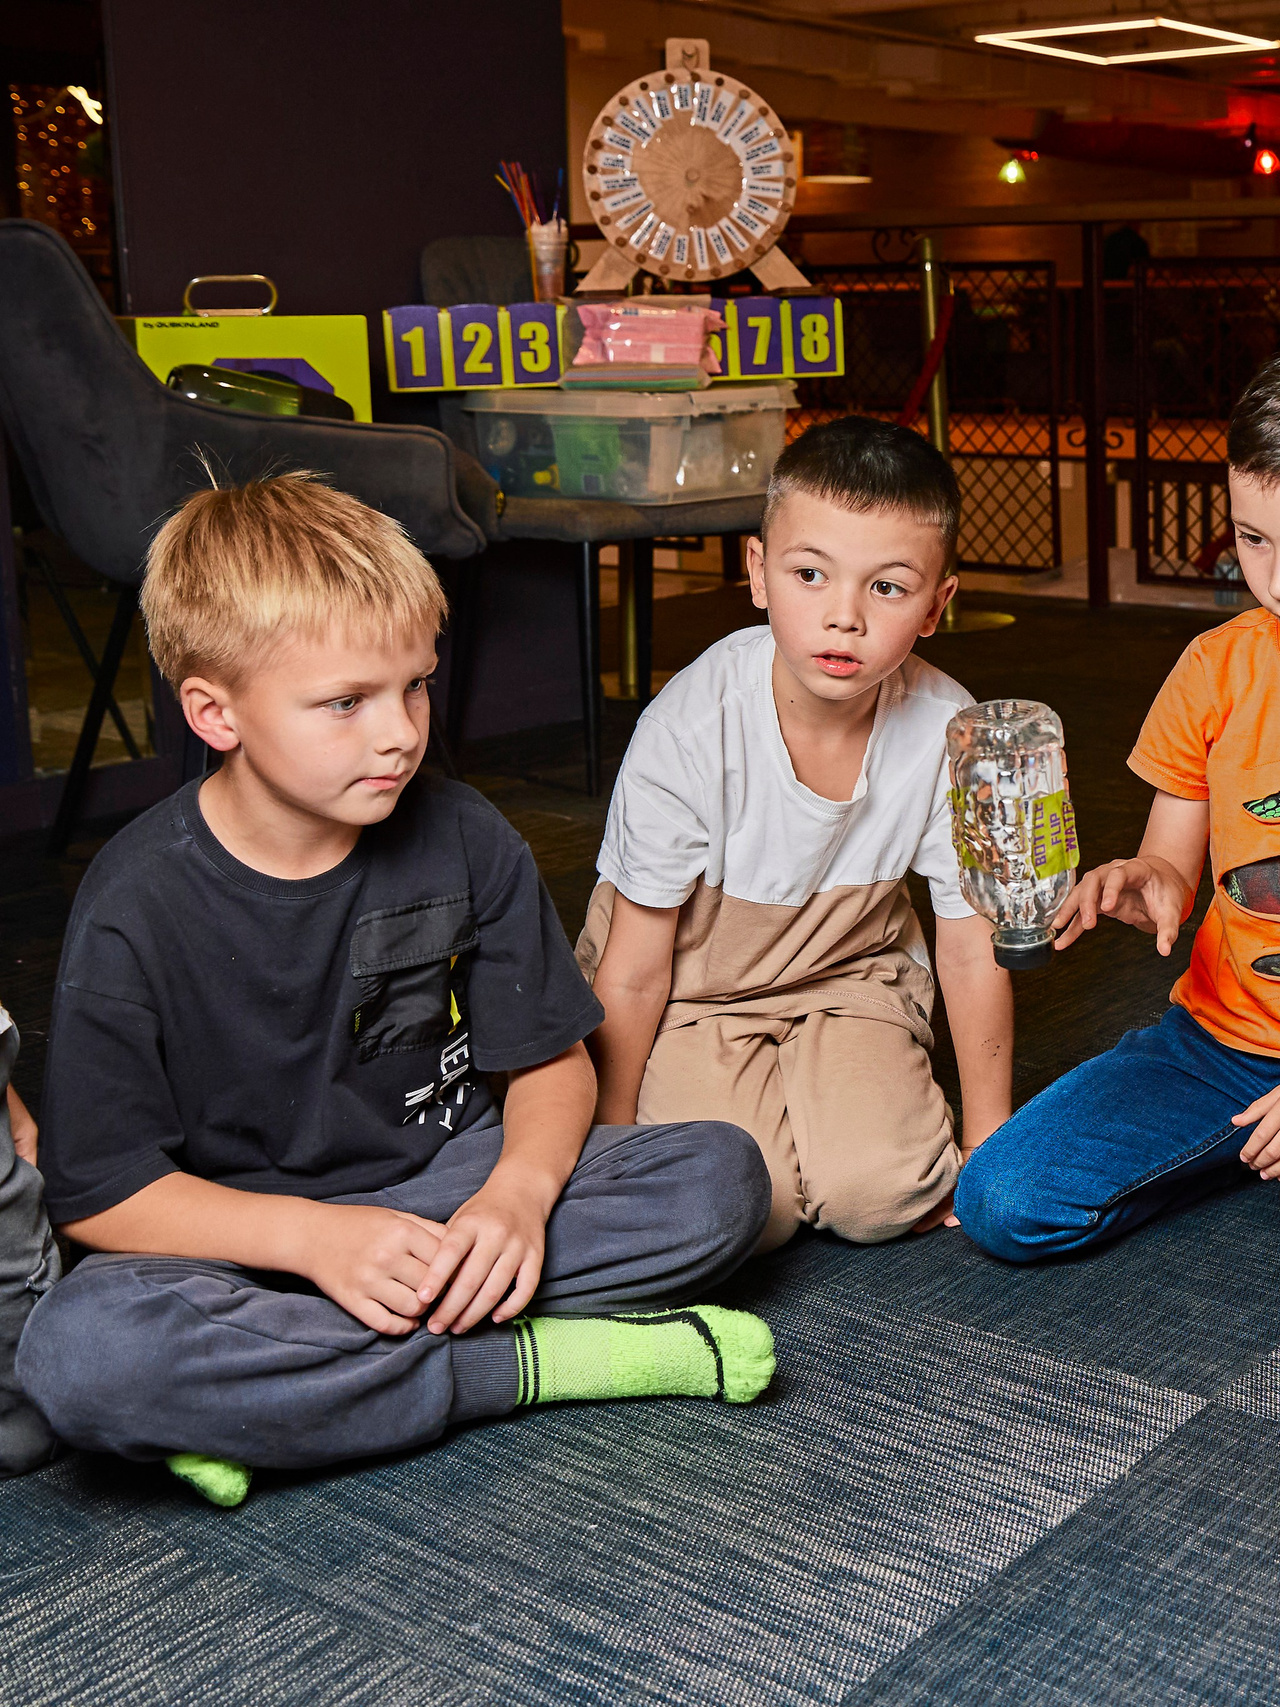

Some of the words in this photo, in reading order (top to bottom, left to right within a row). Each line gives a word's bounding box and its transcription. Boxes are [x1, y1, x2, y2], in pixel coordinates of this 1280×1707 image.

[401, 326, 427, 377] 1
[461, 321, 494, 374] 2
[517, 321, 551, 373] 3
[746, 315, 772, 366] 7
[799, 313, 830, 364] 8
[1049, 812, 1062, 846] FLIP
